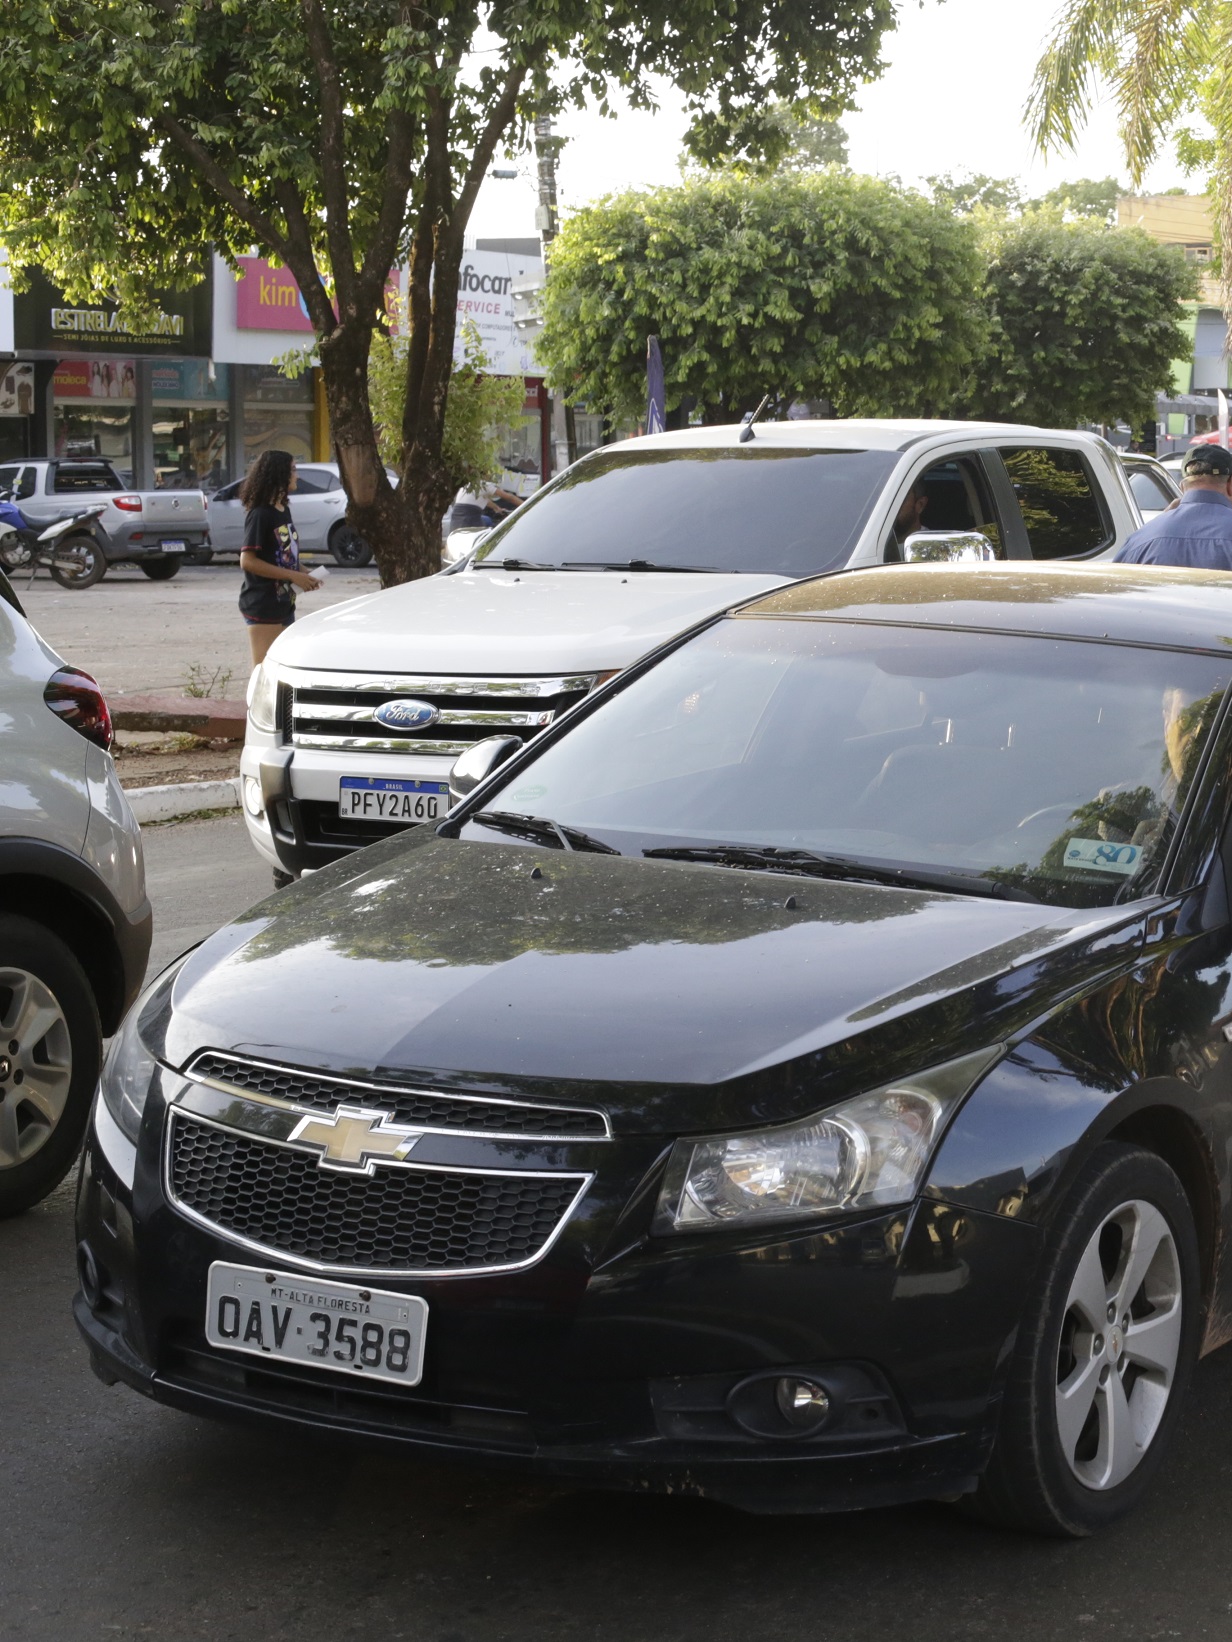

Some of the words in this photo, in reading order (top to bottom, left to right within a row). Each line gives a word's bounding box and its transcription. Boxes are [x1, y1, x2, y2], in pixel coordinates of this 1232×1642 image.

[259, 275, 296, 307] kim
[456, 300, 501, 315] ERVICE
[51, 308, 128, 333] ESTRELA
[385, 705, 420, 721] Ford
[385, 783, 403, 791] BRASIL
[351, 791, 438, 819] PFY2A60
[270, 1287, 315, 1305] MT-ALTA
[317, 1296, 371, 1315] FLORESTA
